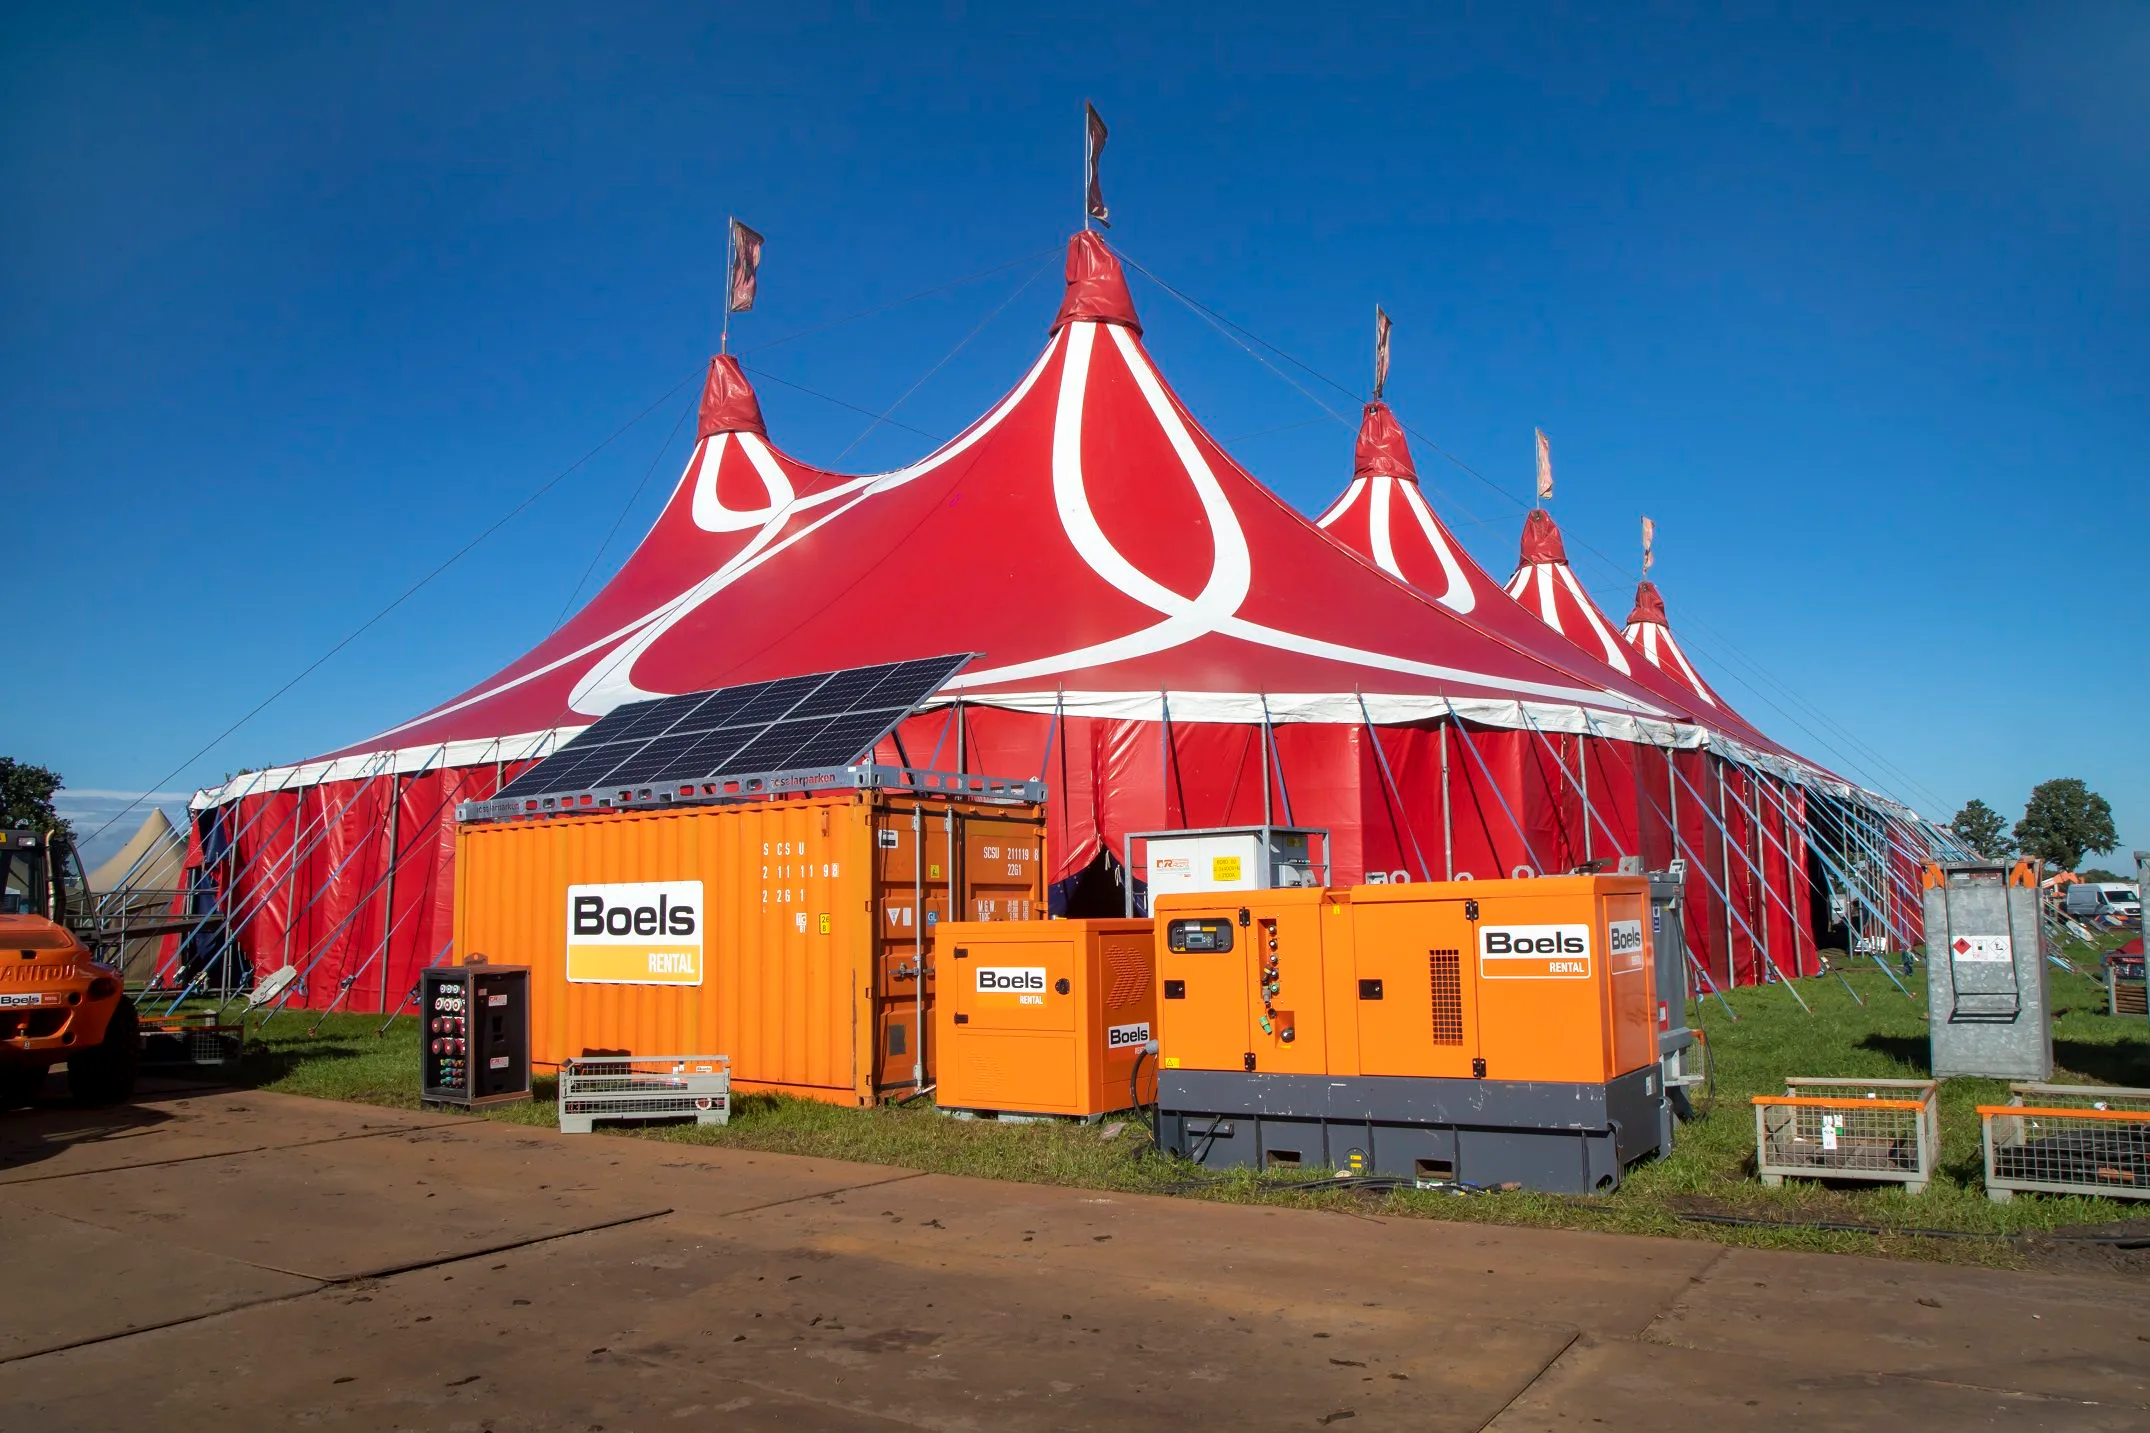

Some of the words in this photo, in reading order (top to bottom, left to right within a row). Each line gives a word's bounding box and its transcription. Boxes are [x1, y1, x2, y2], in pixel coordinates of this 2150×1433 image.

[574, 894, 695, 936] Boels
[1486, 931, 1584, 954] Boels
[1611, 927, 1641, 950] Boels
[0, 964, 76, 981] ANITOU
[649, 953, 695, 974] RENTAL
[1549, 962, 1585, 973] RENTAL
[979, 971, 1043, 989] Boels
[0, 996, 40, 1005] Boels
[1019, 995, 1043, 1005] RENTAL
[1110, 1026, 1148, 1045] Boels
